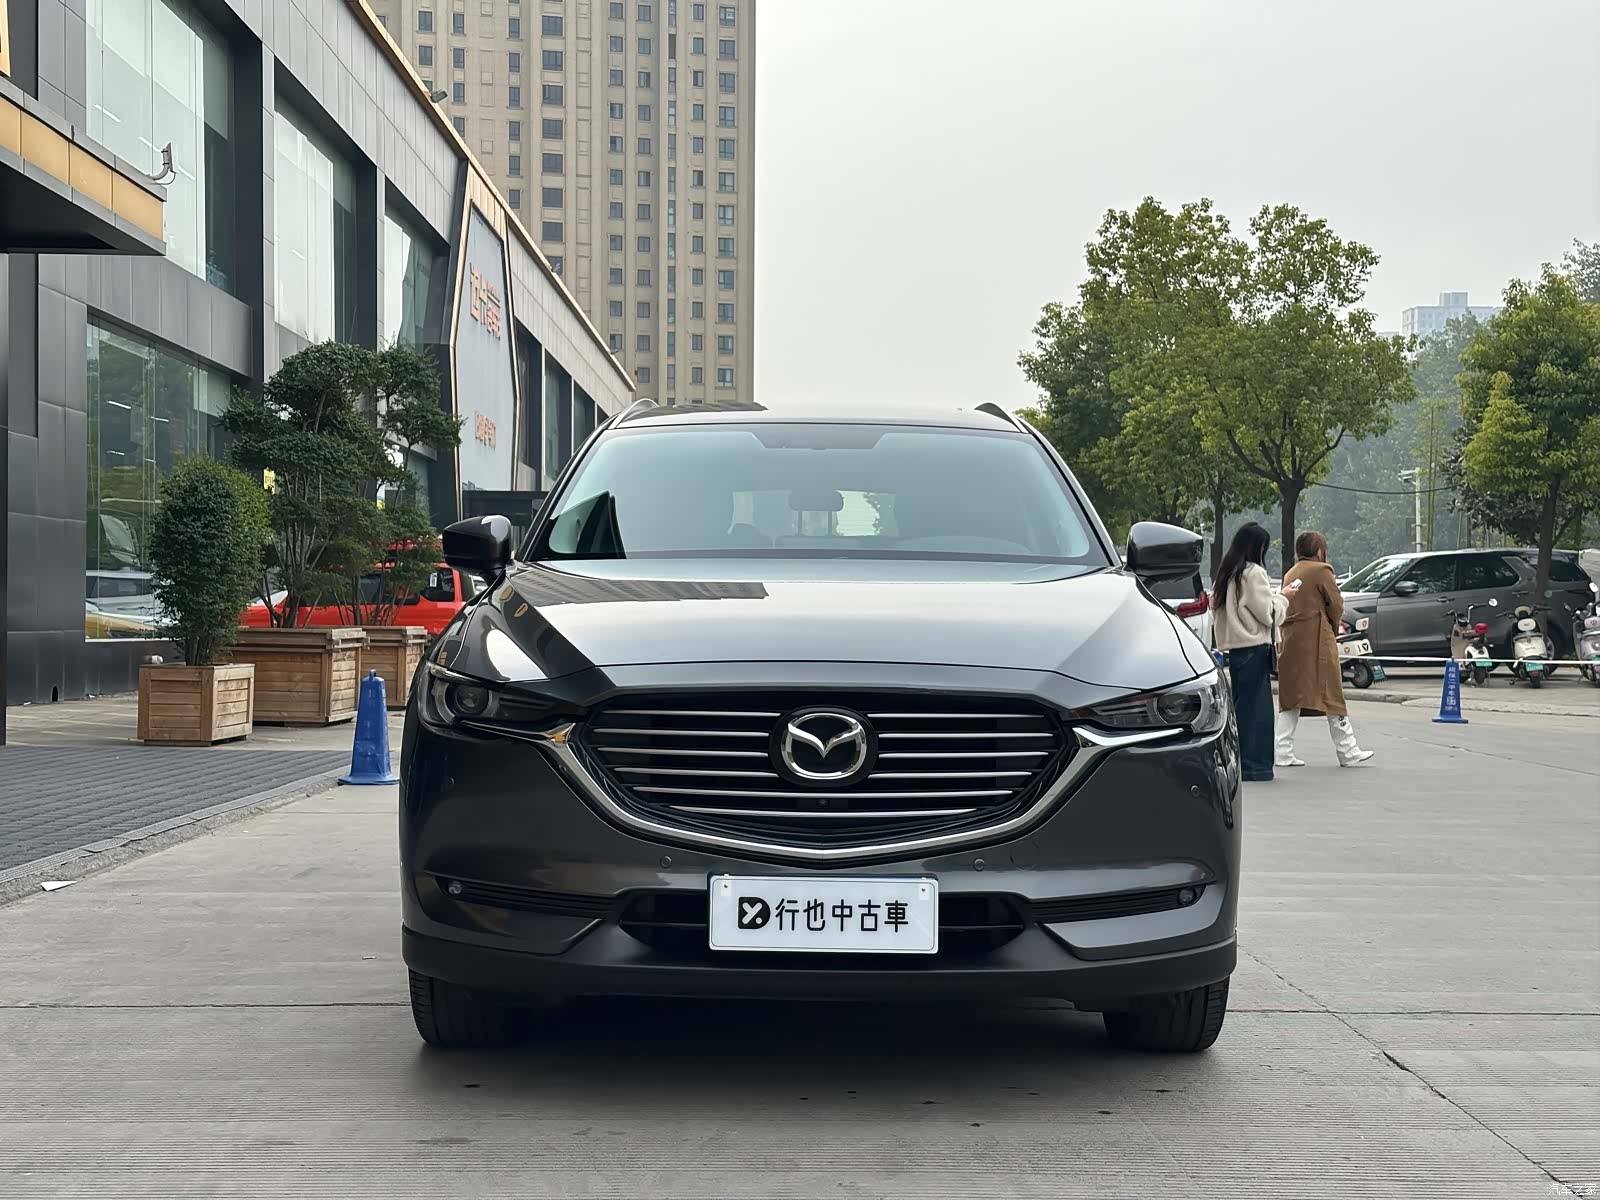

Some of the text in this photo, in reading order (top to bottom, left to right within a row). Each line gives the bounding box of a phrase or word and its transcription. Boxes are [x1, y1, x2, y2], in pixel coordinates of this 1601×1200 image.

[775, 898, 909, 932] 行也中古車
